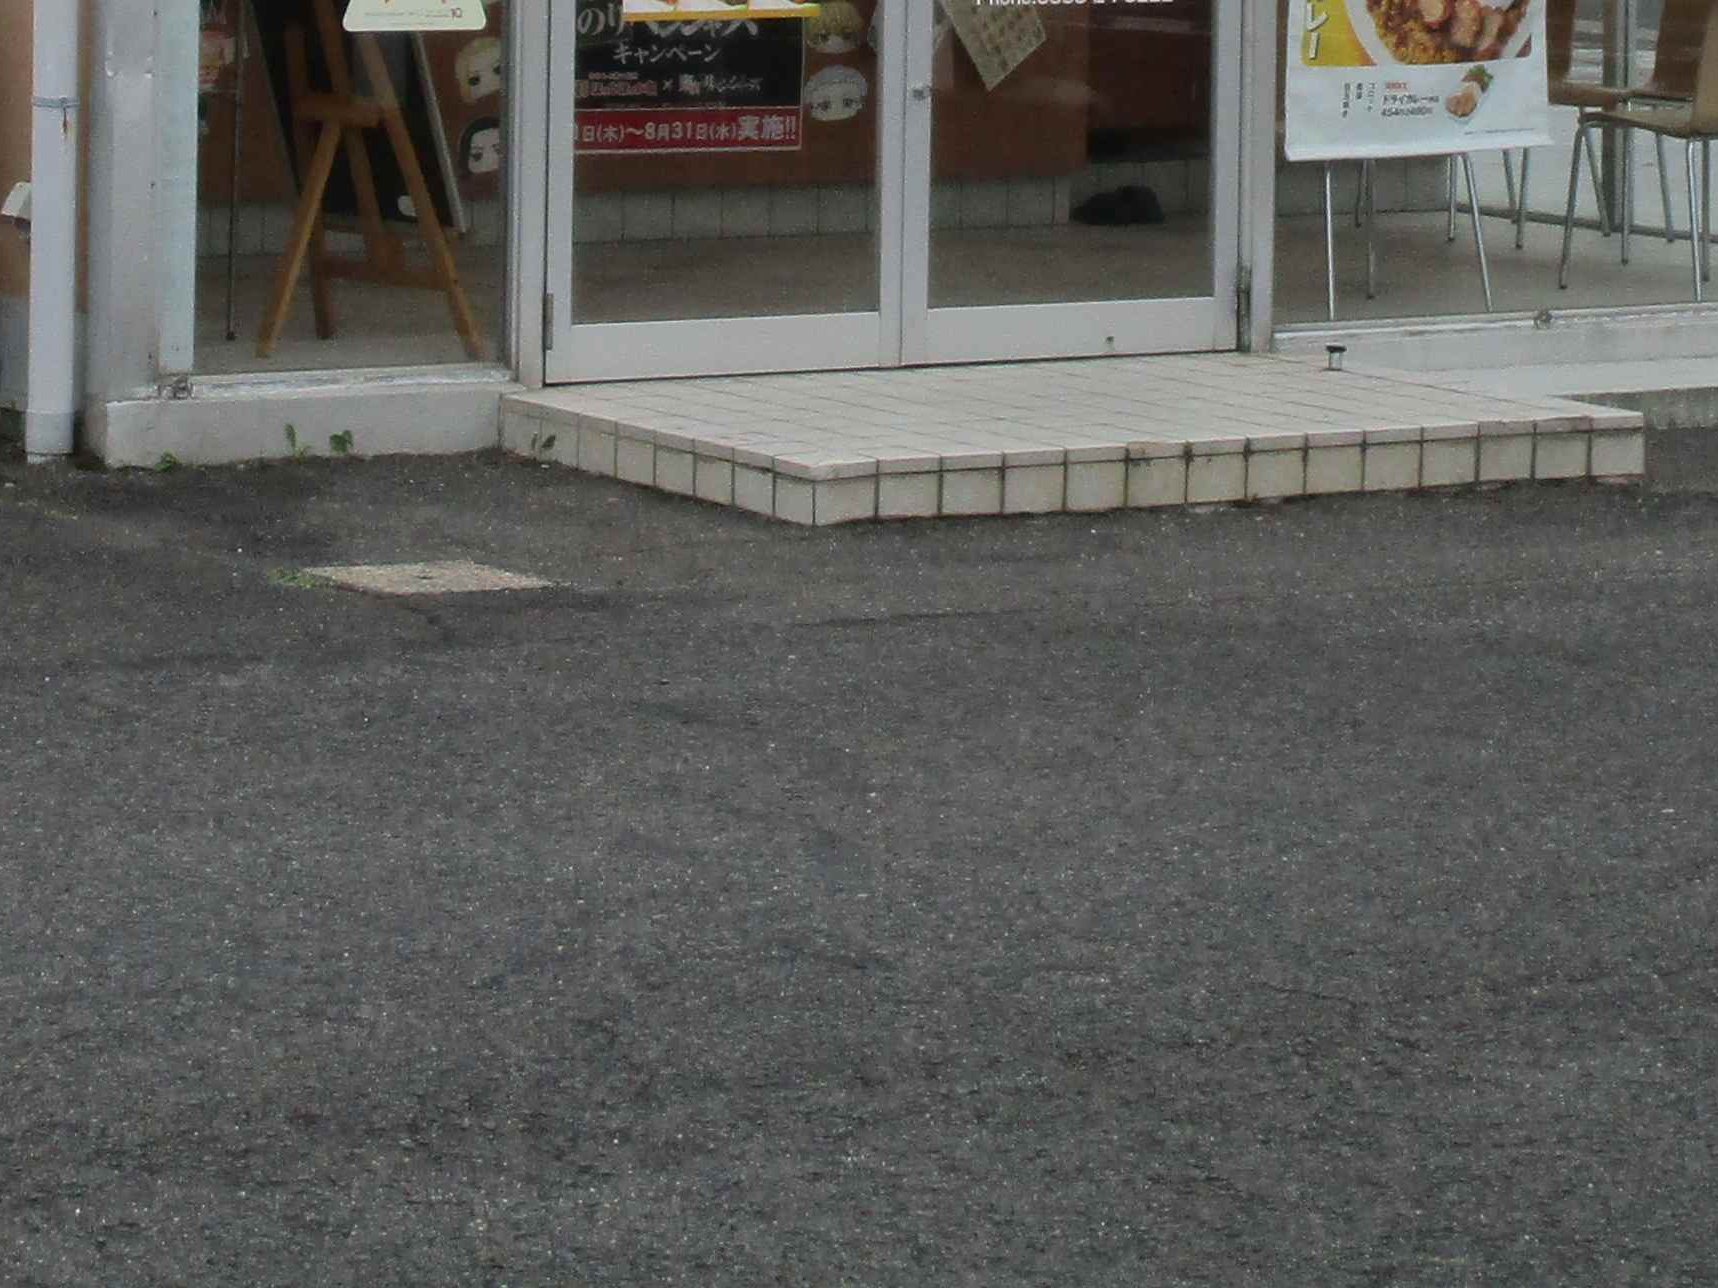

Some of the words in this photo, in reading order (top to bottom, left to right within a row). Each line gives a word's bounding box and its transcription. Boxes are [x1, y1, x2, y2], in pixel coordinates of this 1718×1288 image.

[612, 38, 722, 65] キャンペーン
